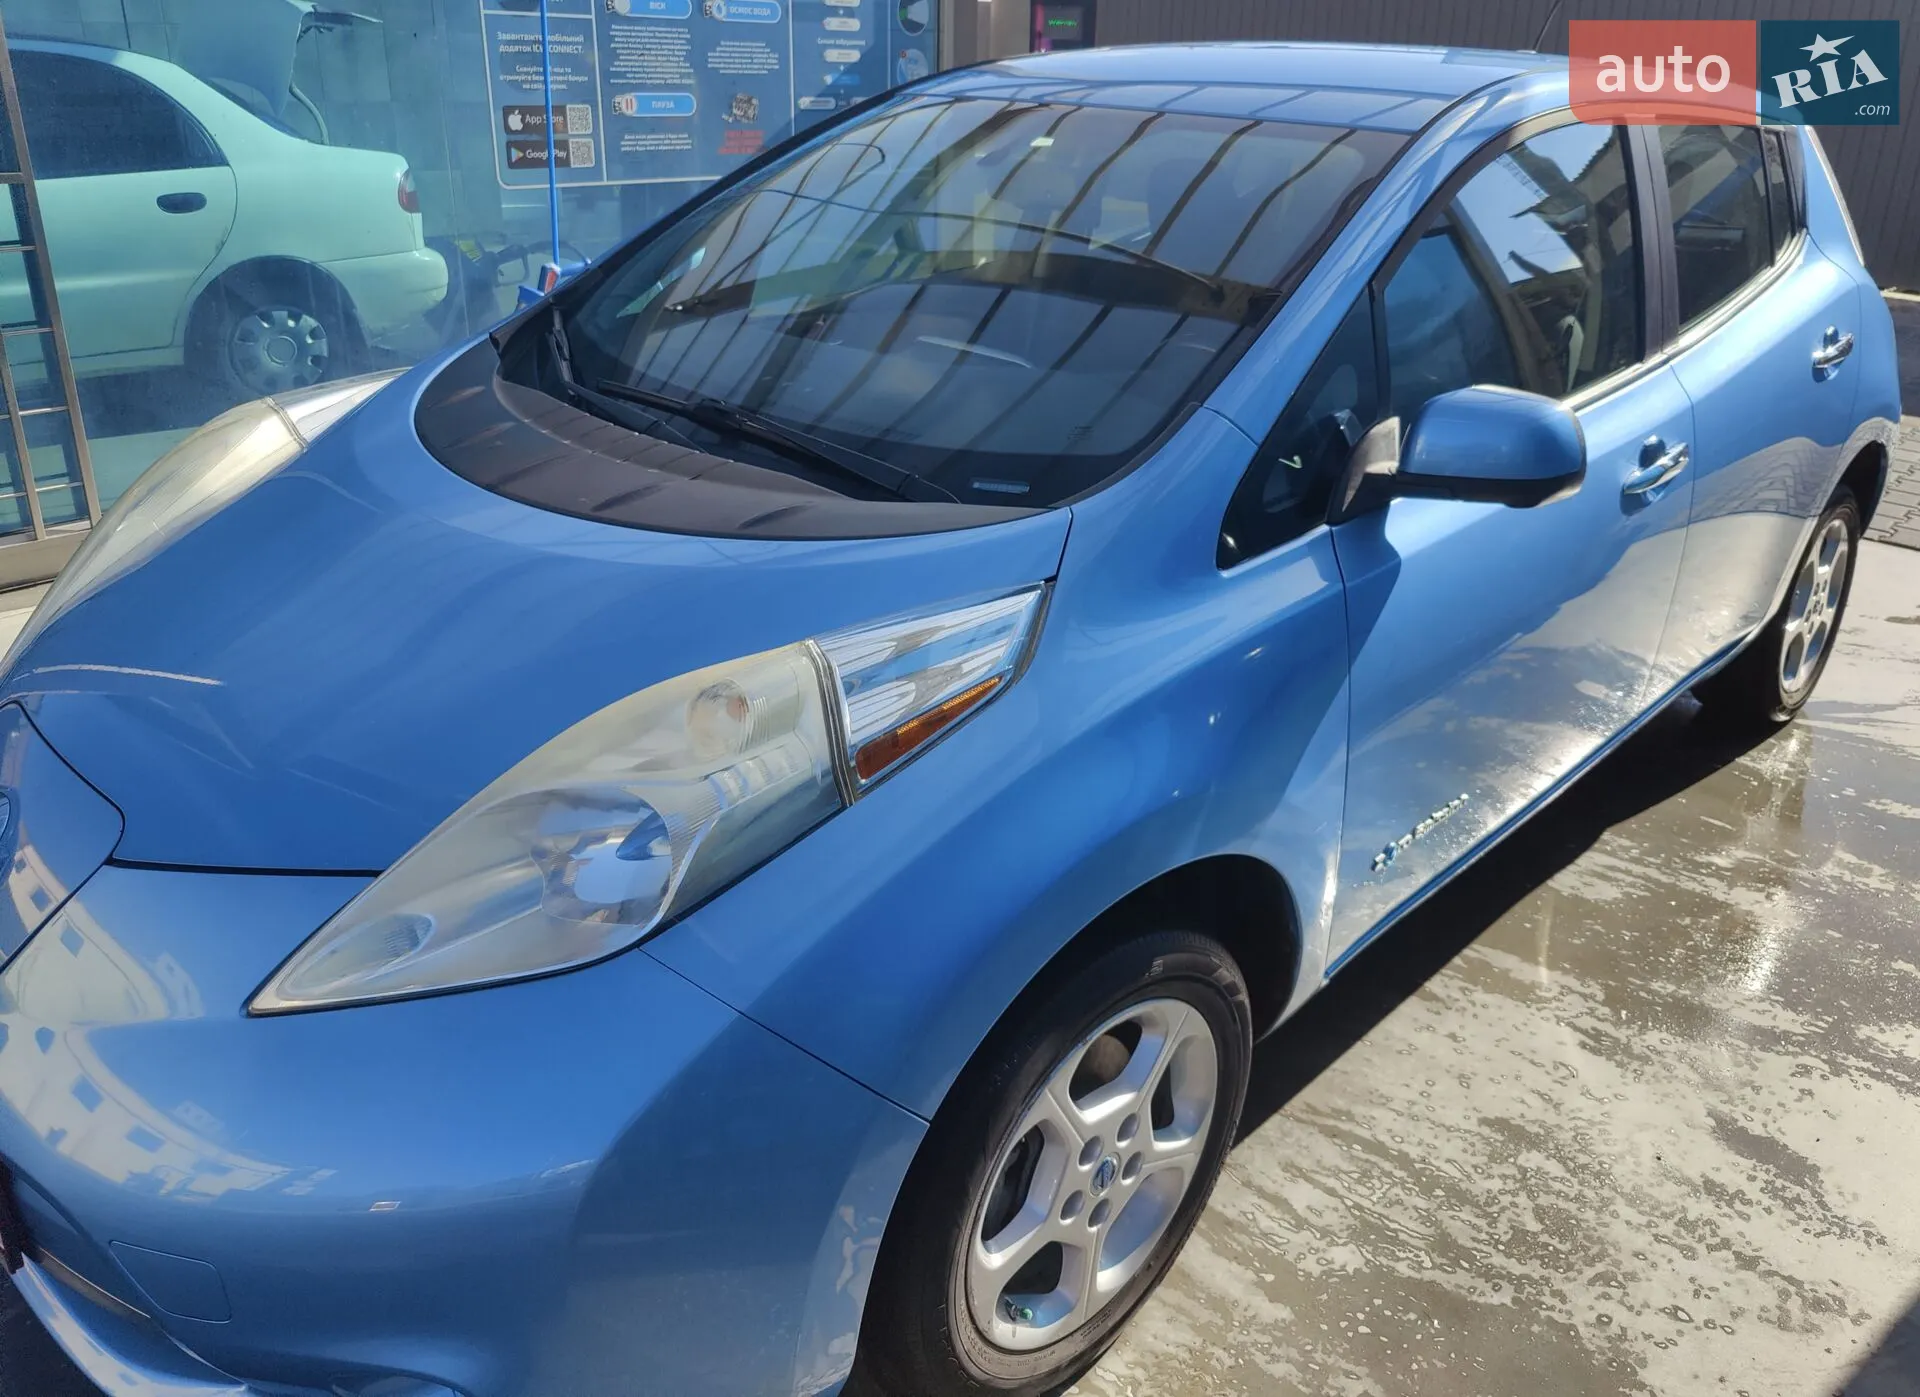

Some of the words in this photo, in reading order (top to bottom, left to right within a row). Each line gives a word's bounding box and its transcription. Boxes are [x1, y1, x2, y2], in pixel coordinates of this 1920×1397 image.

[499, 44, 532, 53] додаток
[525, 114, 542, 126] App
[543, 114, 564, 124] Sore
[526, 149, 551, 160] Googl
[553, 149, 568, 160] Play
